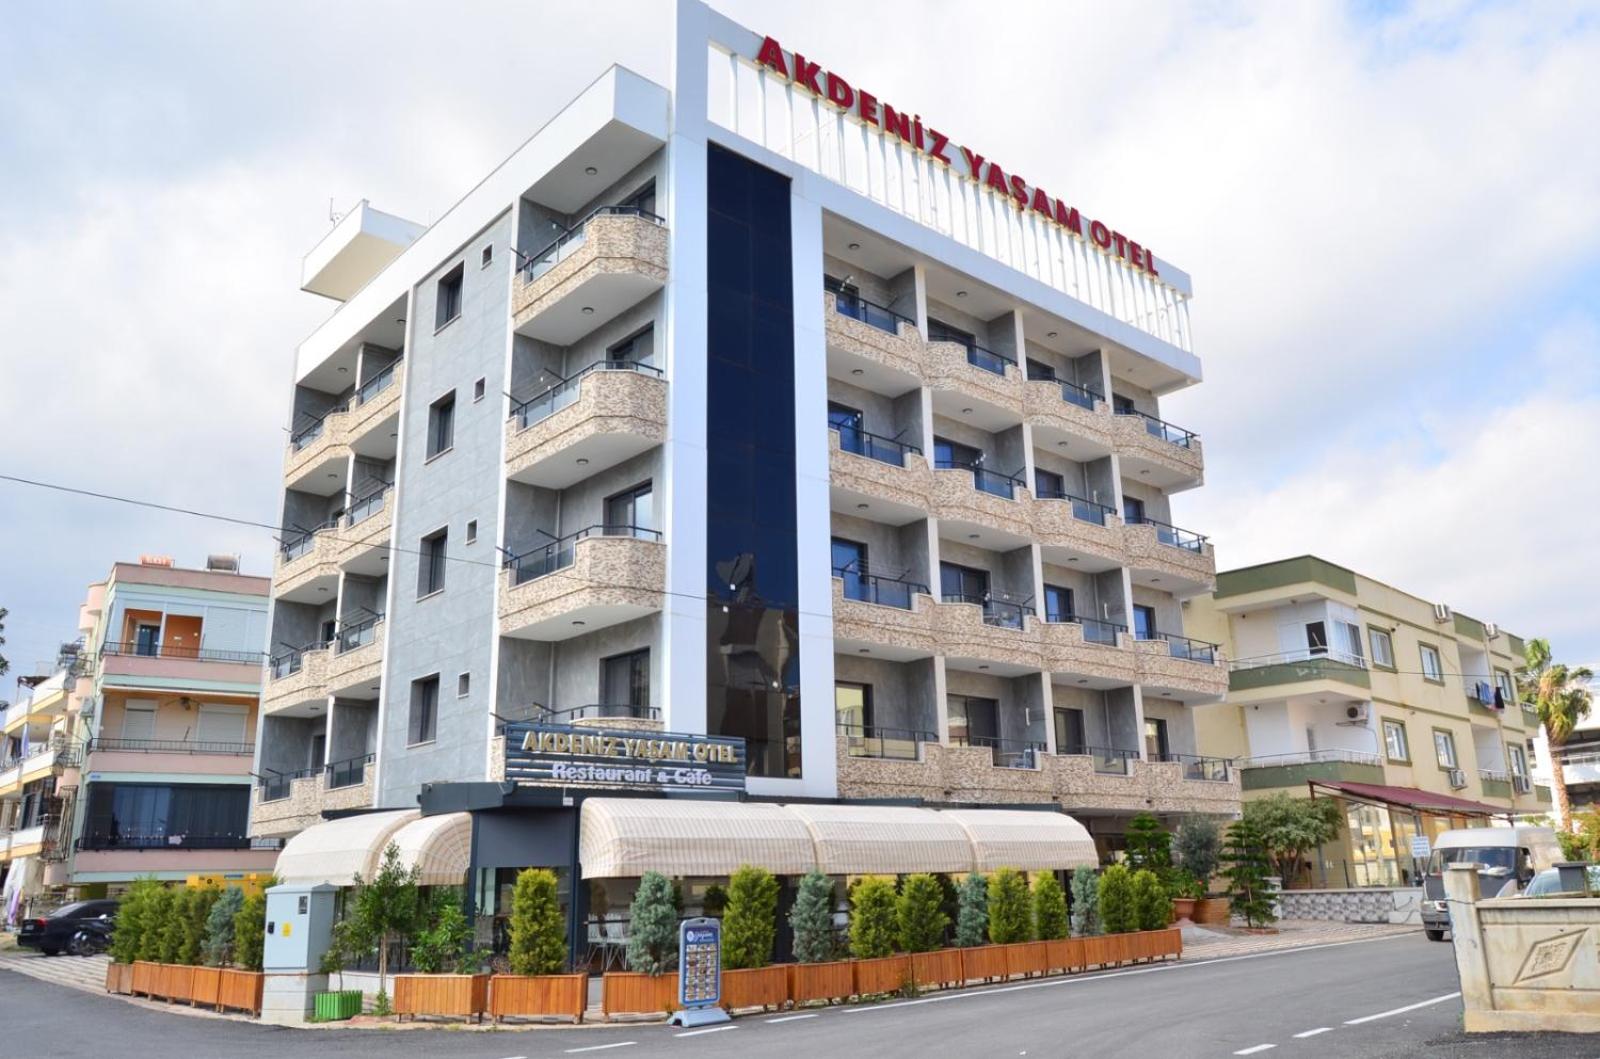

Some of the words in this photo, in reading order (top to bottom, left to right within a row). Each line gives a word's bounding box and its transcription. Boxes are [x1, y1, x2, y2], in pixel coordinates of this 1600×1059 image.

[756, 35, 952, 165] AKDENİZ
[960, 144, 1083, 237] YAŞAM
[1089, 219, 1159, 277] OTEL
[521, 731, 618, 757] AKDENİZ
[623, 738, 690, 762] YAŞAM
[693, 743, 738, 763] OTEL
[551, 764, 651, 783] Restaurant
[674, 767, 713, 785] Cafe
